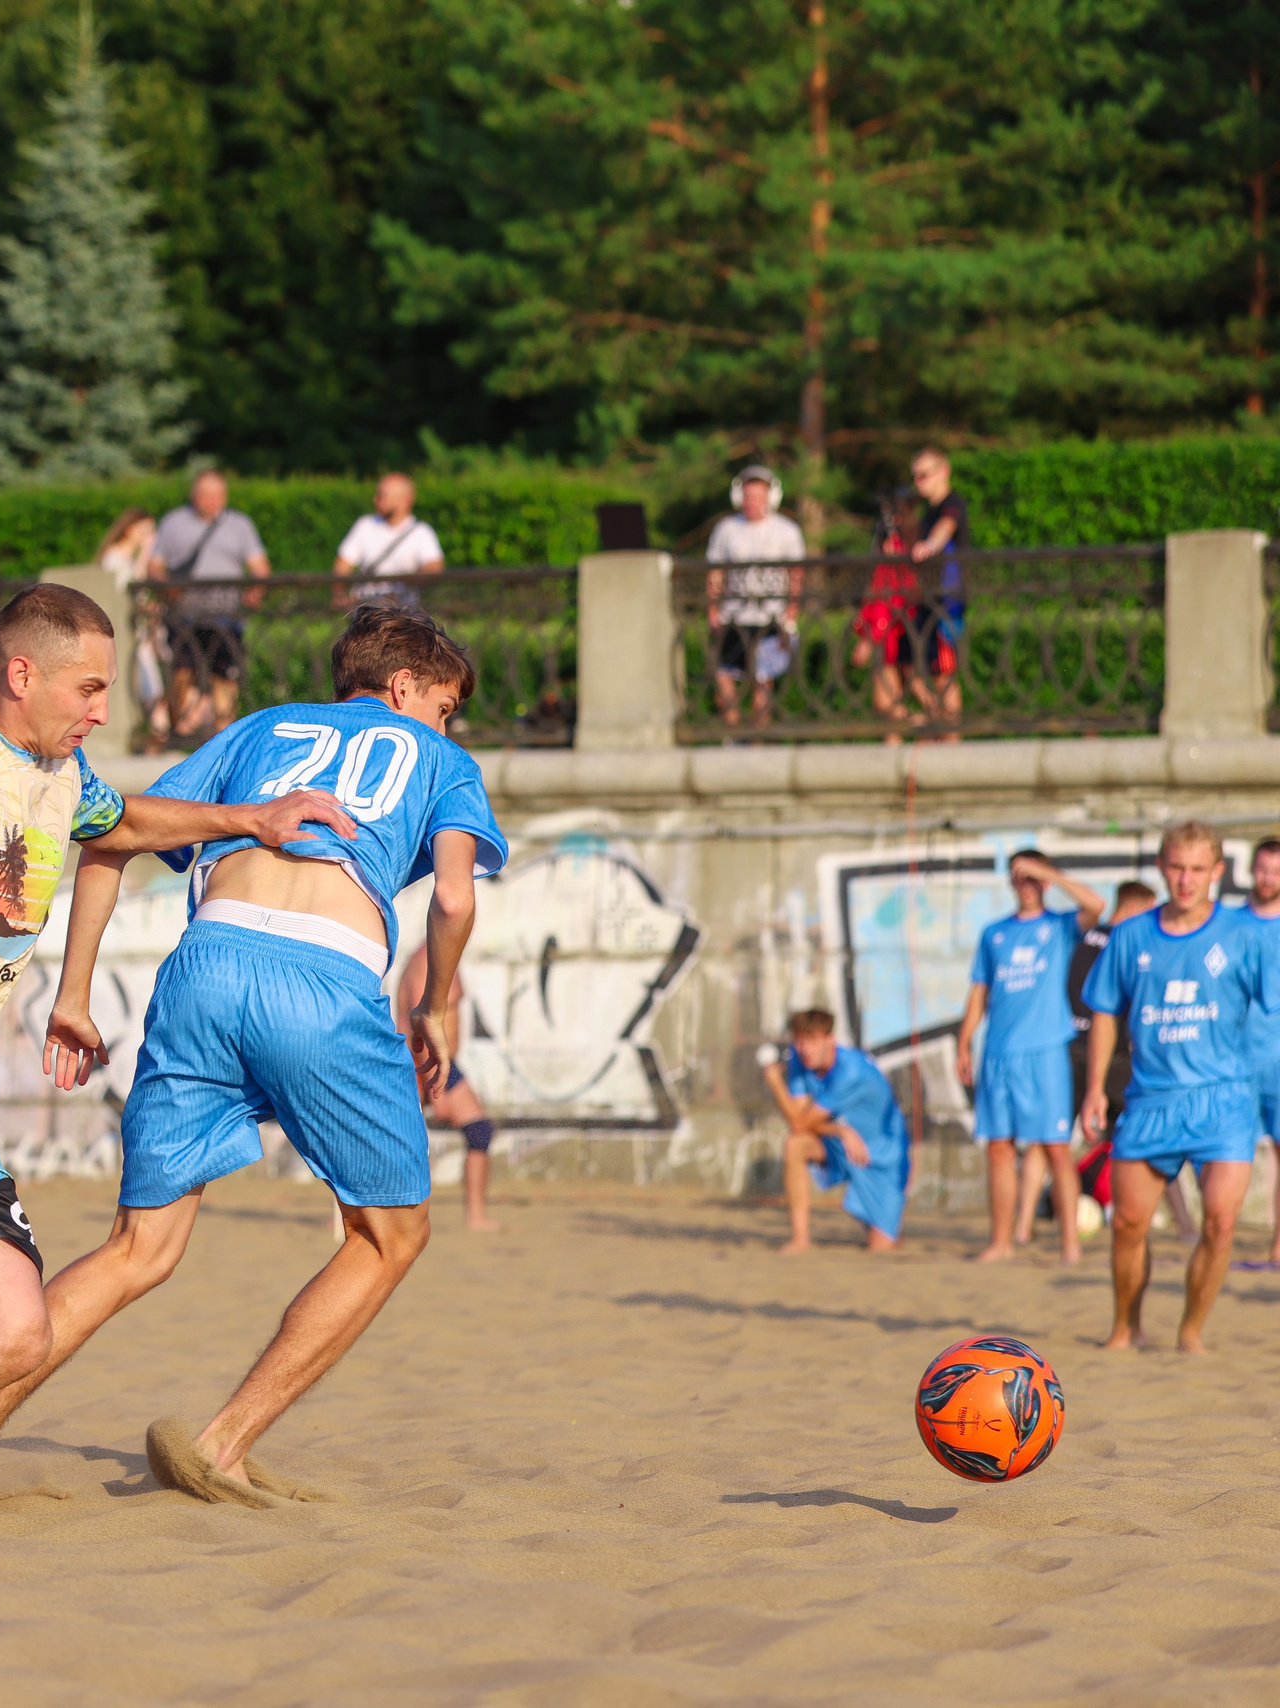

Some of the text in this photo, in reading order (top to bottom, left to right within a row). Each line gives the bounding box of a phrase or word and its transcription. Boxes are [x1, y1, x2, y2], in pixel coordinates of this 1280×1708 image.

[259, 721, 419, 823] 20
[1141, 1000, 1219, 1025] Земский
[1158, 1024, 1200, 1044] банк
[959, 1406, 968, 1437] TRIUMPH
